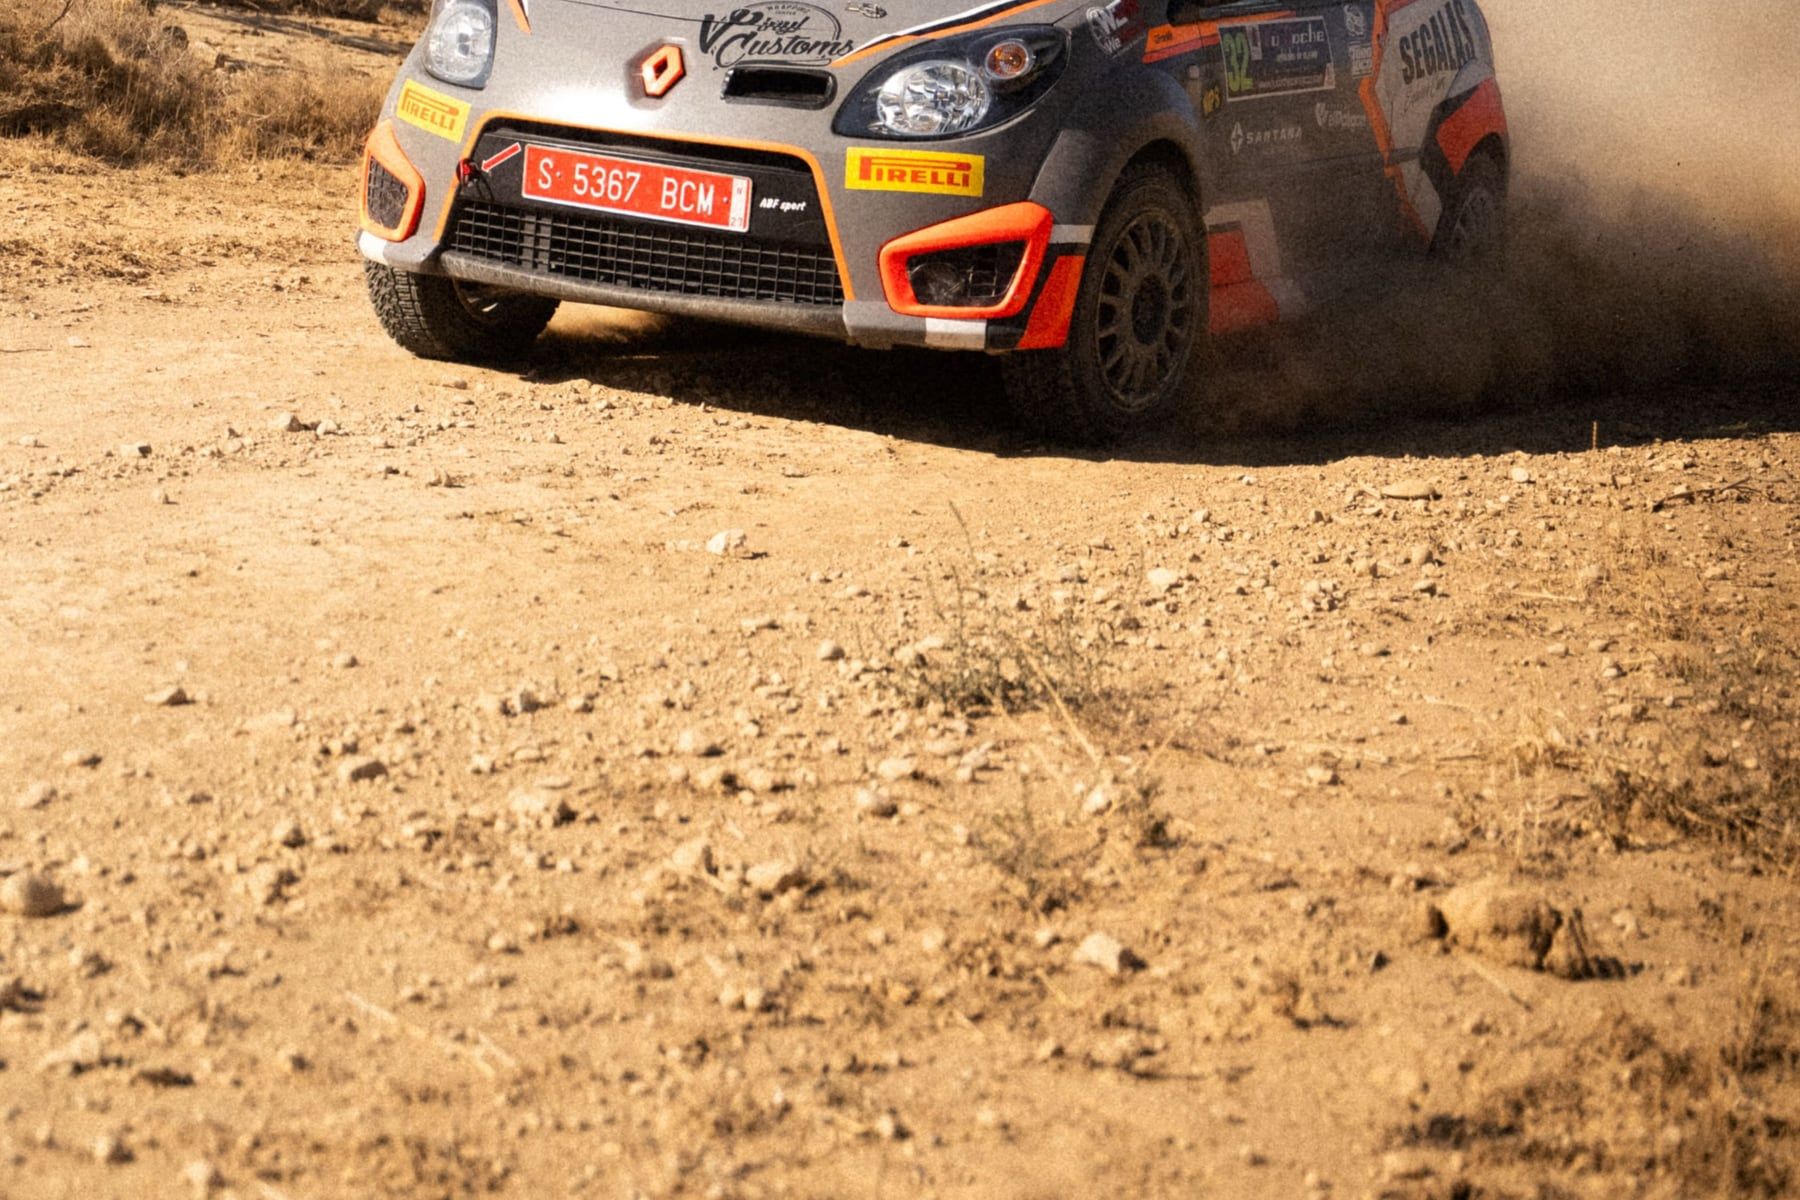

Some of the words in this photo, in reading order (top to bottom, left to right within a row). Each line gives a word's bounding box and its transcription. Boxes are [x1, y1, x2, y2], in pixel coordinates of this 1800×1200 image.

[715, 31, 856, 68] Customs
[1222, 32, 1254, 92] 32
[401, 87, 460, 132] PIRELLI
[1246, 126, 1303, 145] SANTANA
[537, 157, 554, 190] S
[572, 162, 641, 203] 5367
[660, 176, 715, 216] BCM
[858, 155, 972, 188] PIRELLI
[759, 197, 780, 209] ABF
[780, 200, 806, 213] sport
